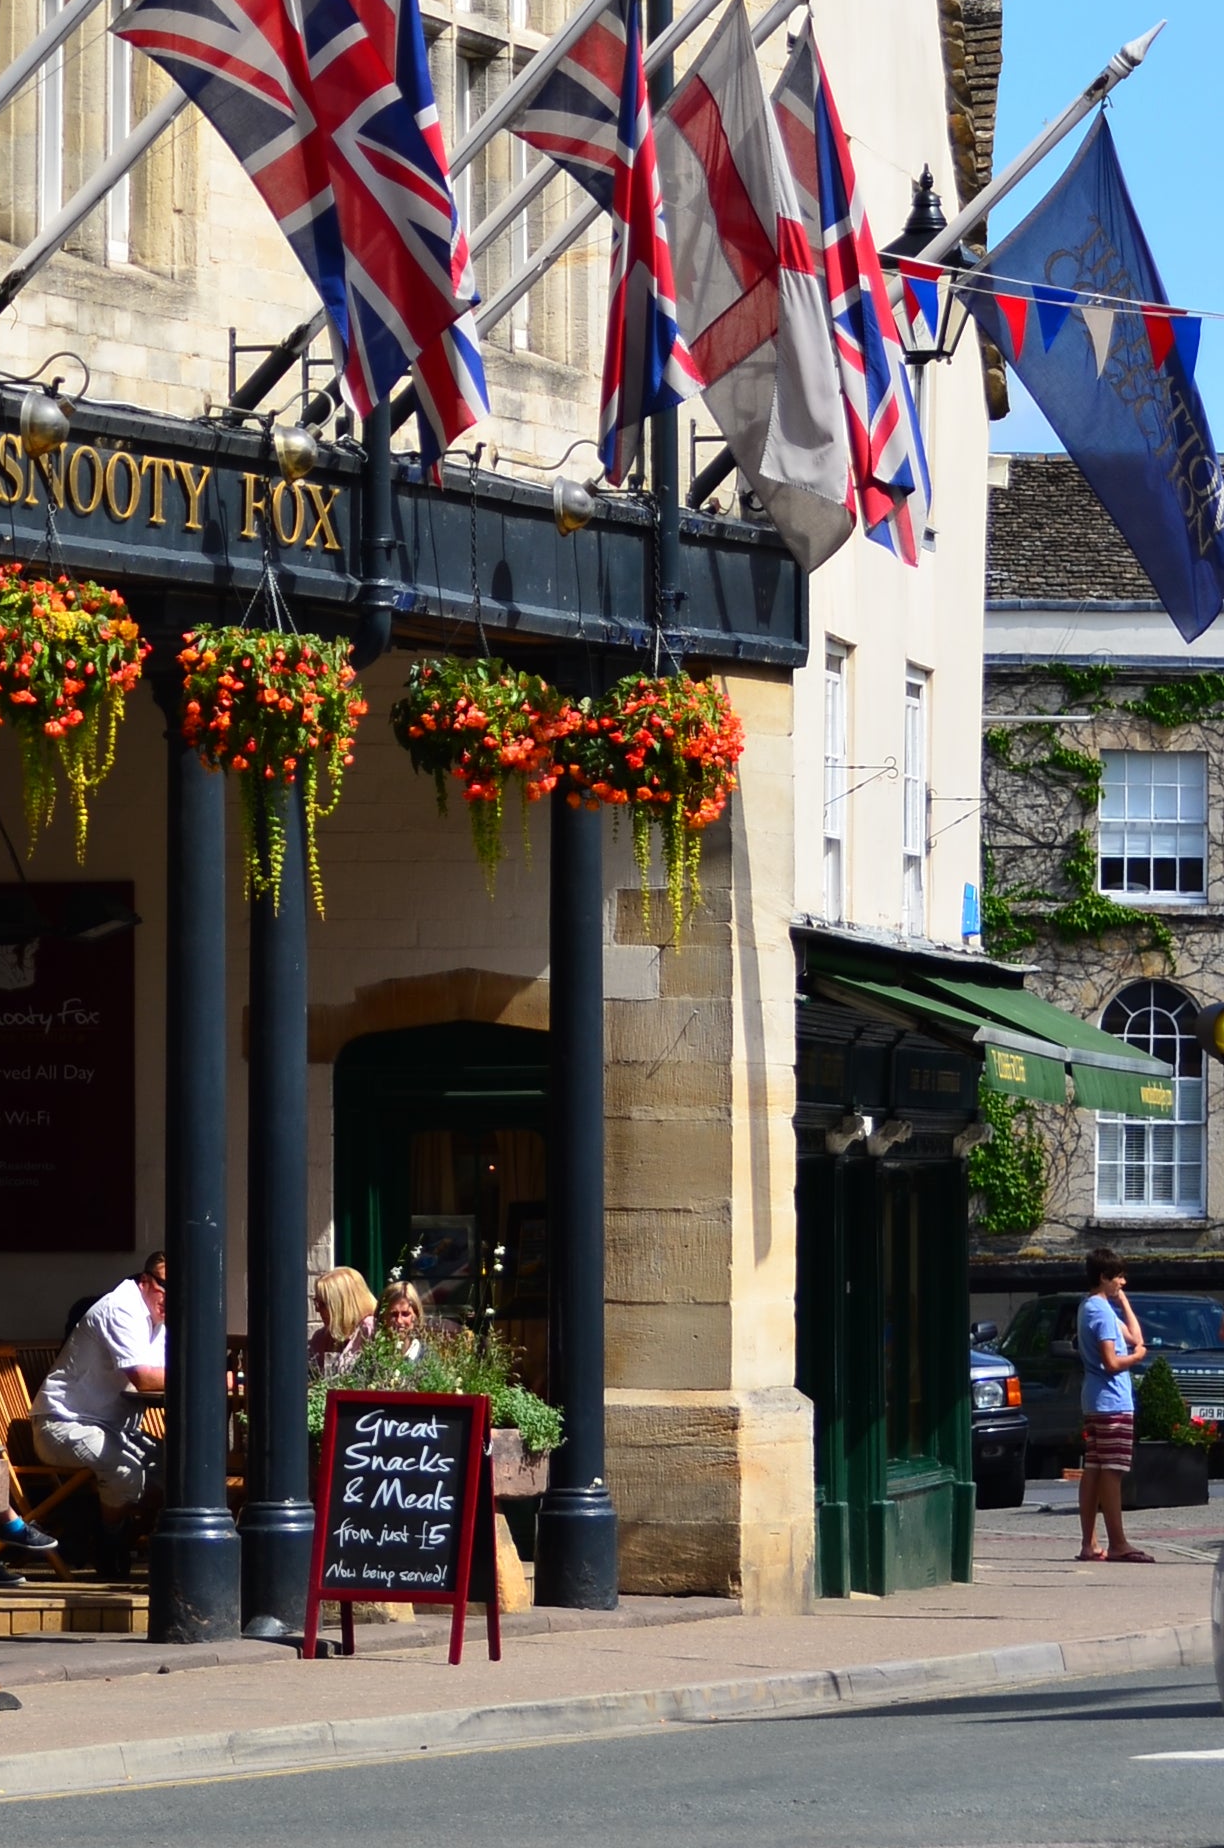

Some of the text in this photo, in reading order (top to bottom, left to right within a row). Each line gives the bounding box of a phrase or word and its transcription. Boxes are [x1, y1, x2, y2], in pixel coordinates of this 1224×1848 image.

[240, 471, 343, 551] FOX
[58, 997, 101, 1027] Fox
[34, 1063, 57, 1081] All
[63, 1063, 96, 1085] Day
[5, 1110, 51, 1128] Wi-Fi
[354, 1409, 450, 1445] Great
[343, 1441, 456, 1474] Snacks
[342, 1476, 455, 1512] & Meals
[332, 1517, 452, 1551] from just £5
[325, 1559, 449, 1588] Now being served!
